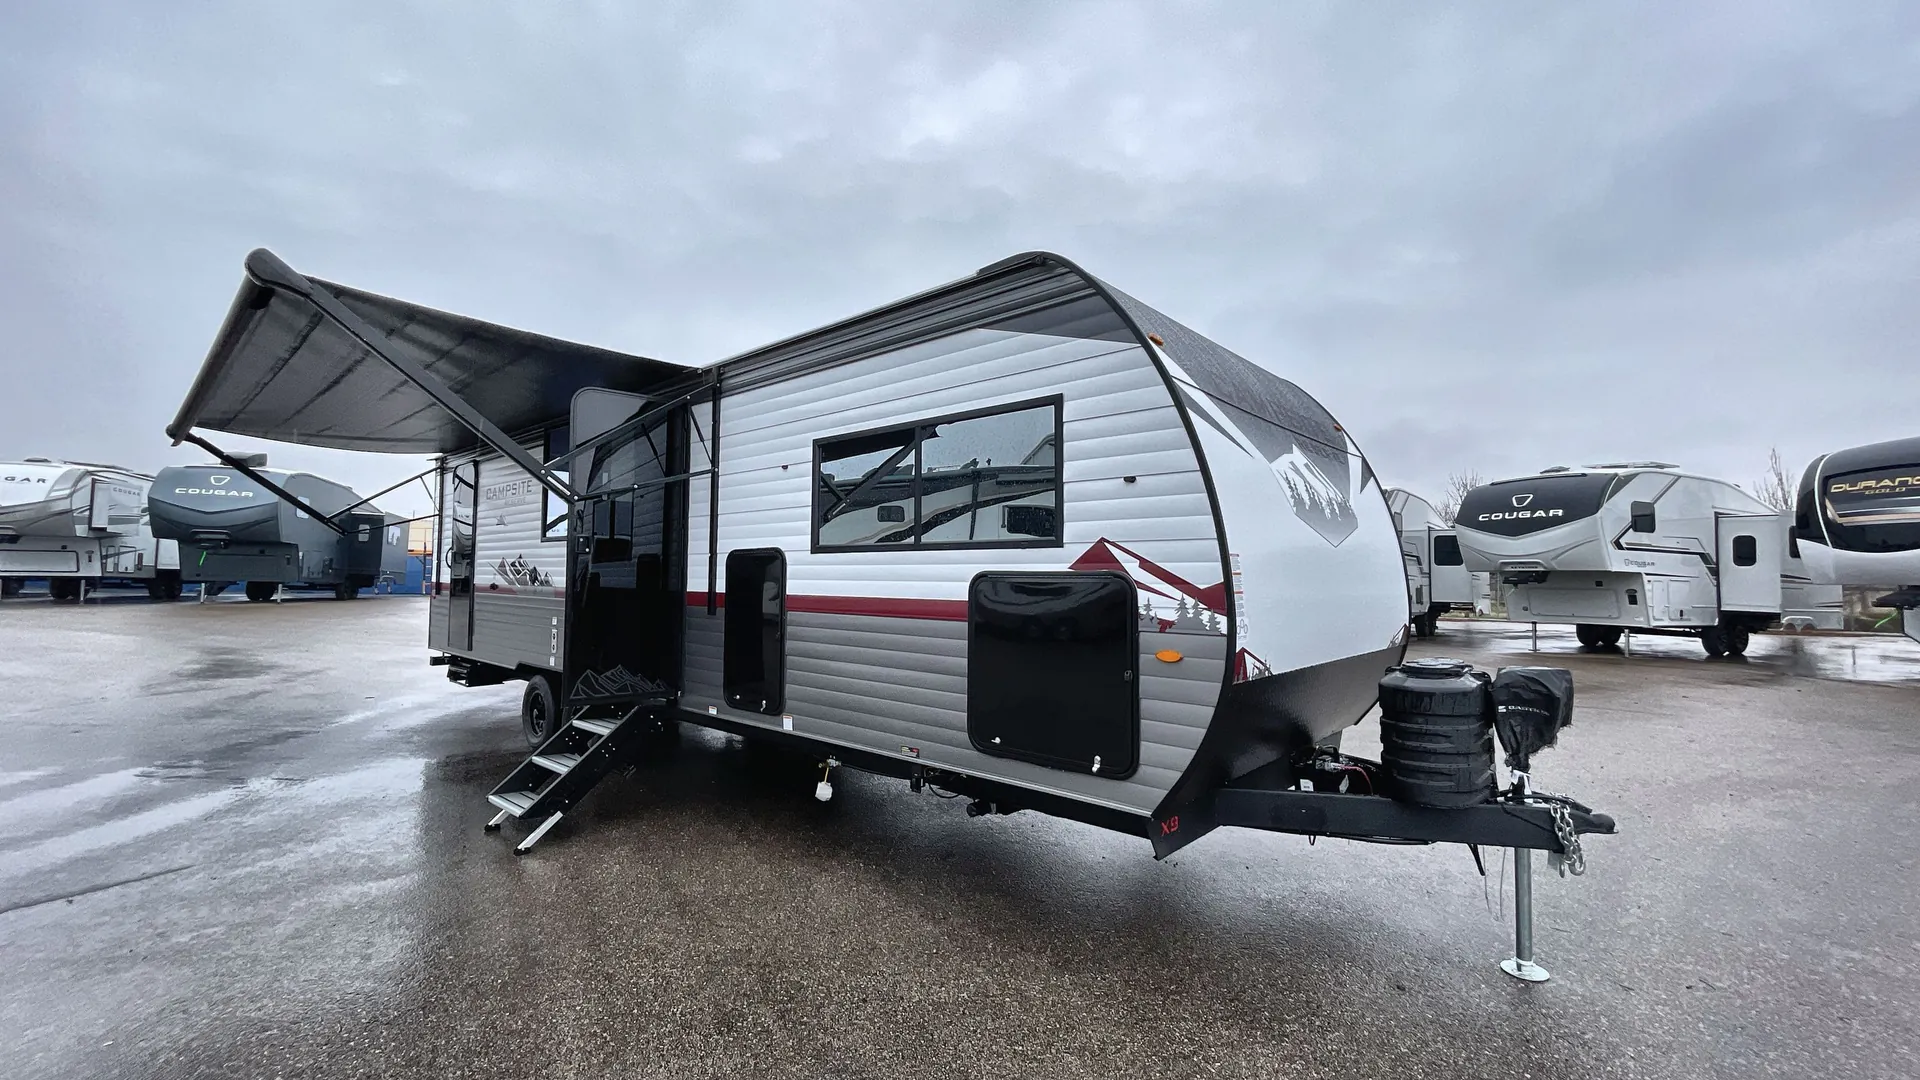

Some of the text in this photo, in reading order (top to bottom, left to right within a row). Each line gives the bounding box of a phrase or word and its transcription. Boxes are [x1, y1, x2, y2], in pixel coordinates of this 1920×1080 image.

[112, 487, 140, 497] COUGAR
[175, 487, 254, 498] COUGAR
[486, 479, 533, 500] CAMPSITE
[1864, 487, 1906, 495] GOLD
[1478, 509, 1564, 521] COUGAR
